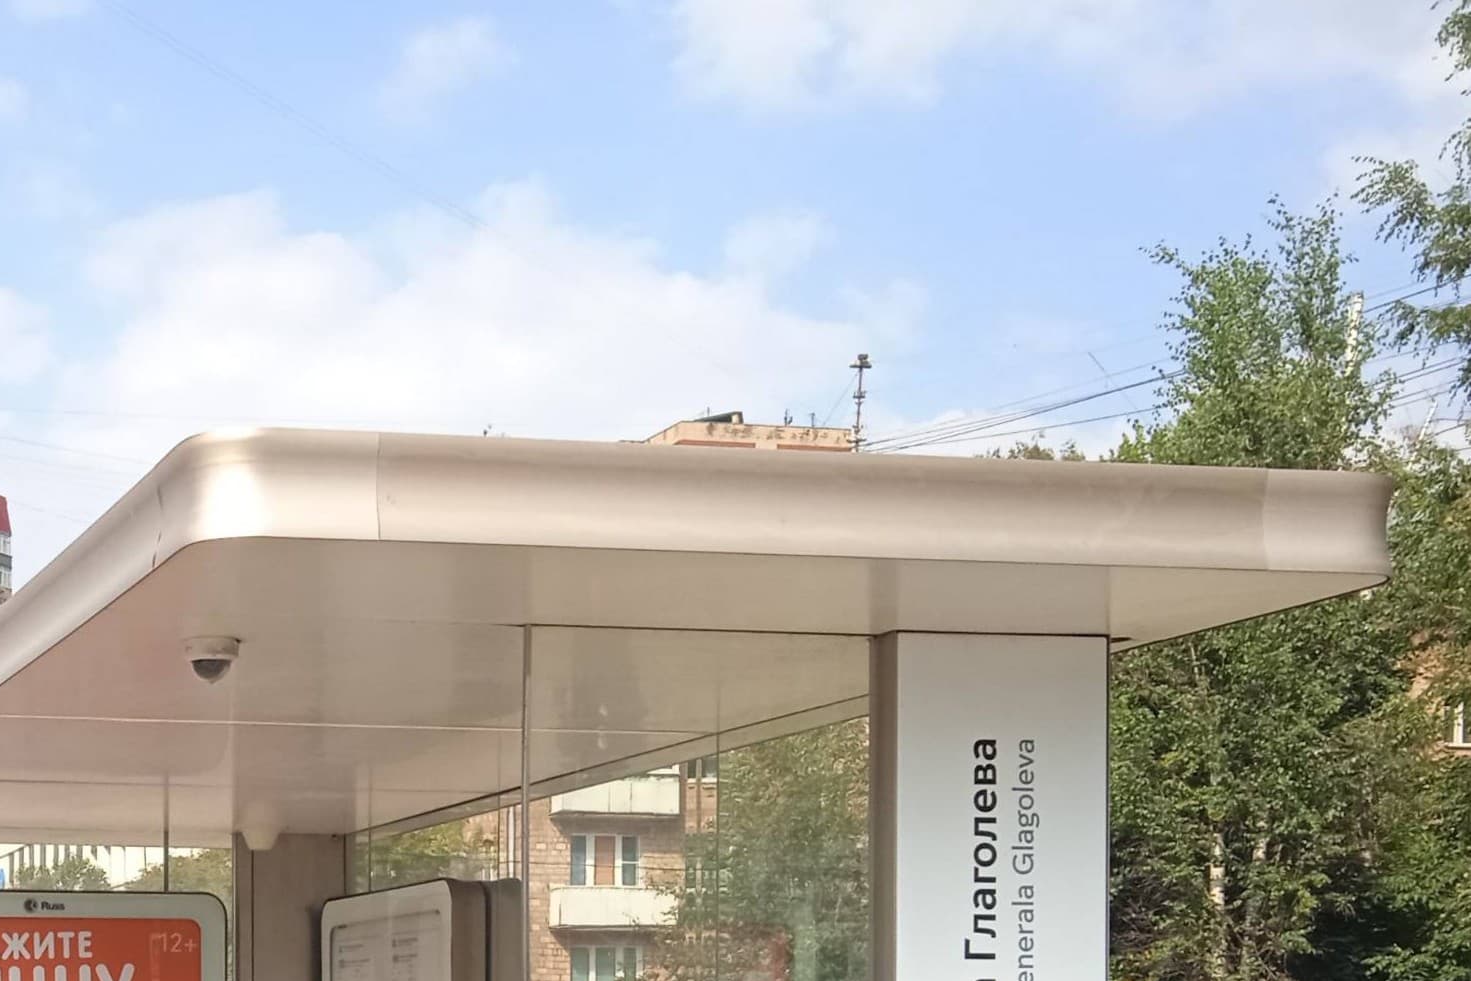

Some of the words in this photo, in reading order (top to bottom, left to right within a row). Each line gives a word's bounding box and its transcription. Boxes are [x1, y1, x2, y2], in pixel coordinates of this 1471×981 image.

[1012, 738, 1041, 876] Glagoleva
[964, 738, 998, 960] Глаголева
[40, 900, 65, 911] Russ
[159, 932, 197, 953] 12+
